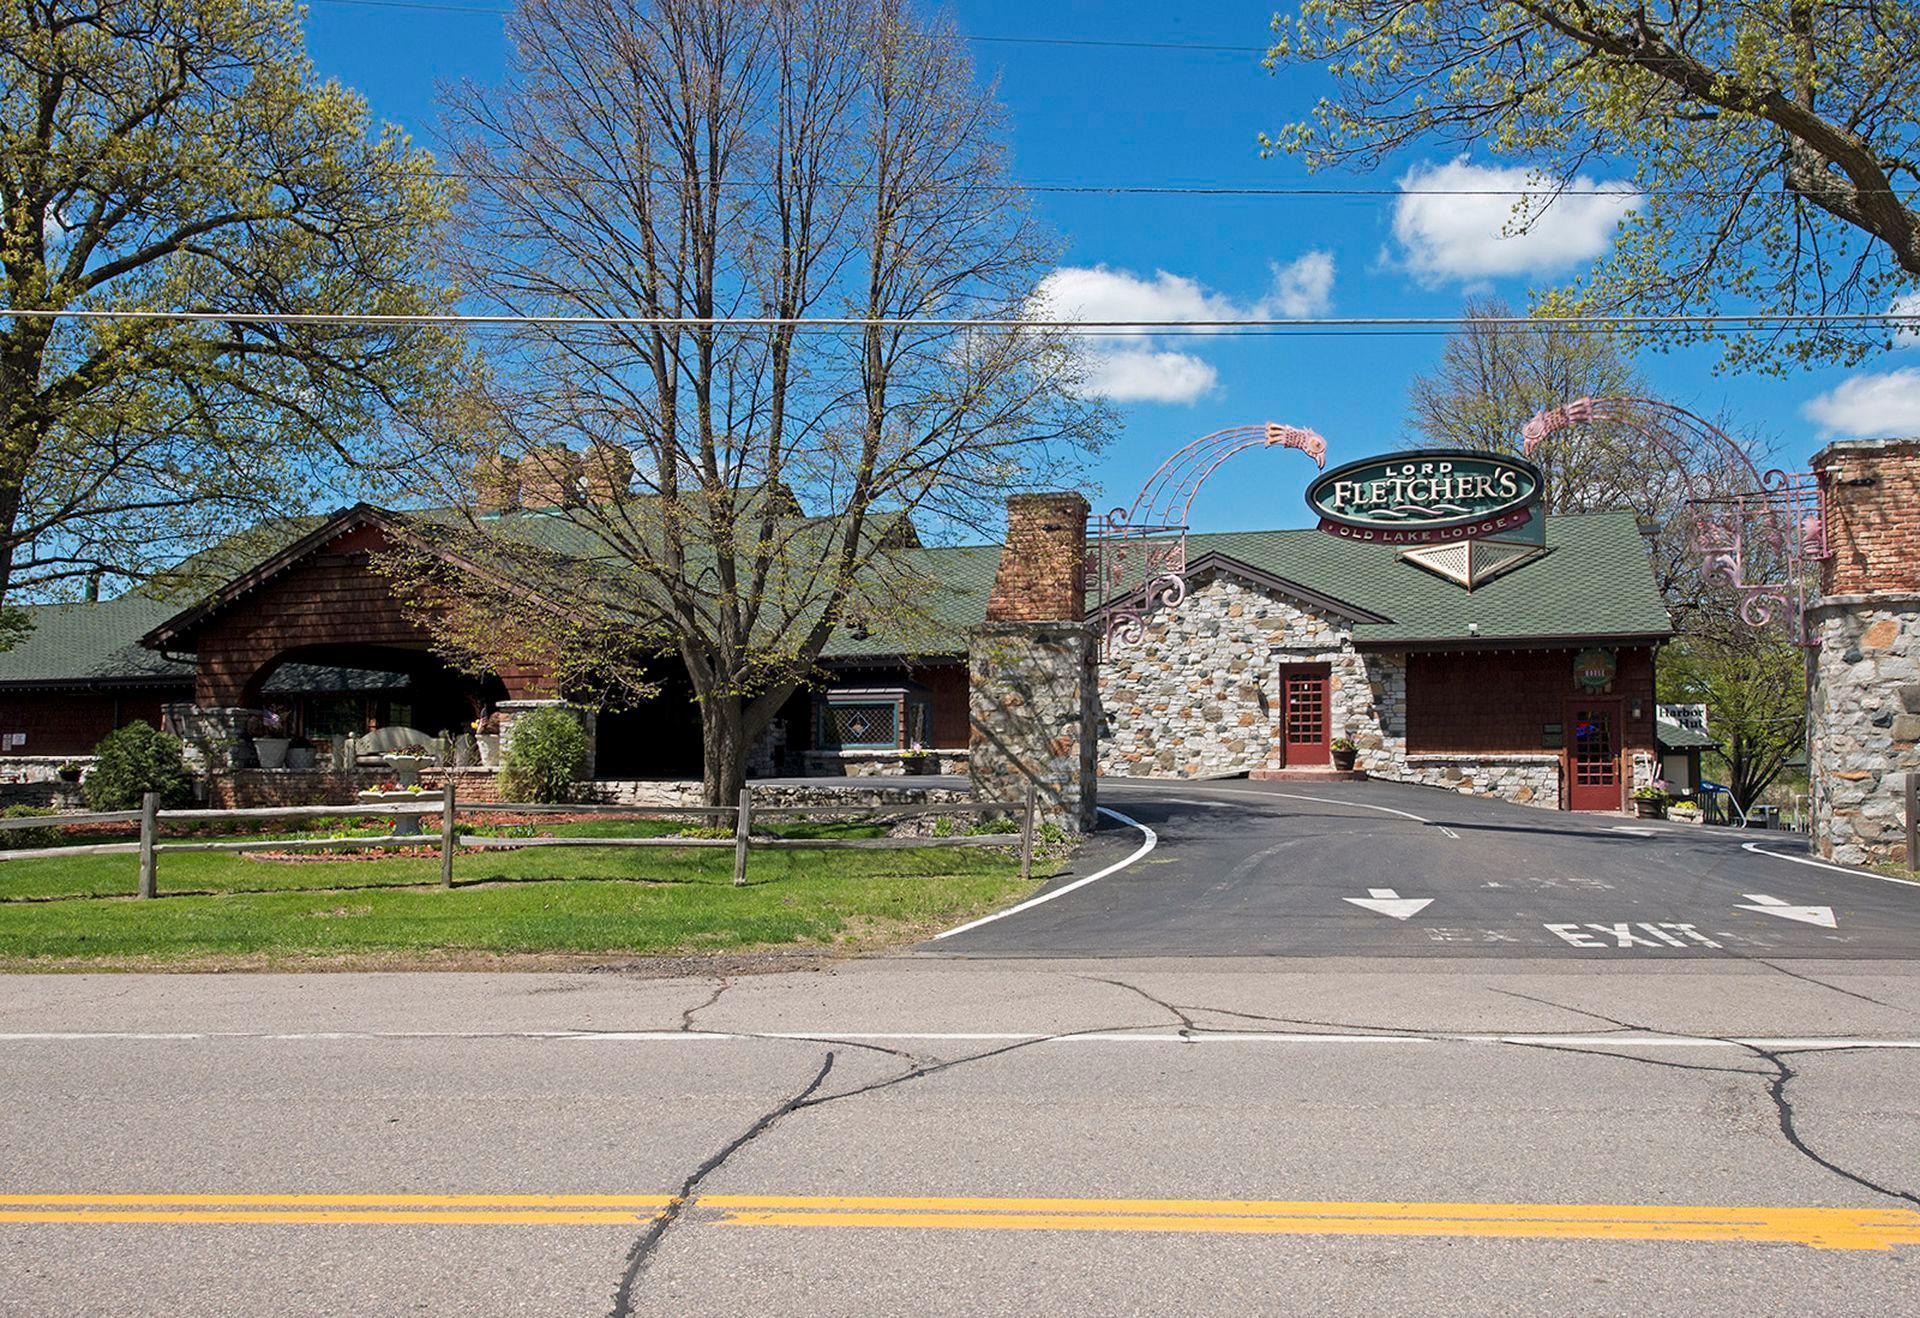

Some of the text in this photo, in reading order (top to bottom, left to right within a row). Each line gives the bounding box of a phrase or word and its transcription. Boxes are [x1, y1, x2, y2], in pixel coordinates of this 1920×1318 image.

[1386, 463, 1452, 476] LORD
[1333, 467, 1517, 507] FLETCHER'S
[1339, 527, 1374, 540] OLD
[1383, 532, 1431, 541] LAKE
[1441, 518, 1507, 539] LODGE
[1659, 708, 1704, 717] Harbor
[1679, 719, 1703, 728] Hut
[1543, 923, 1723, 948] EXIT
